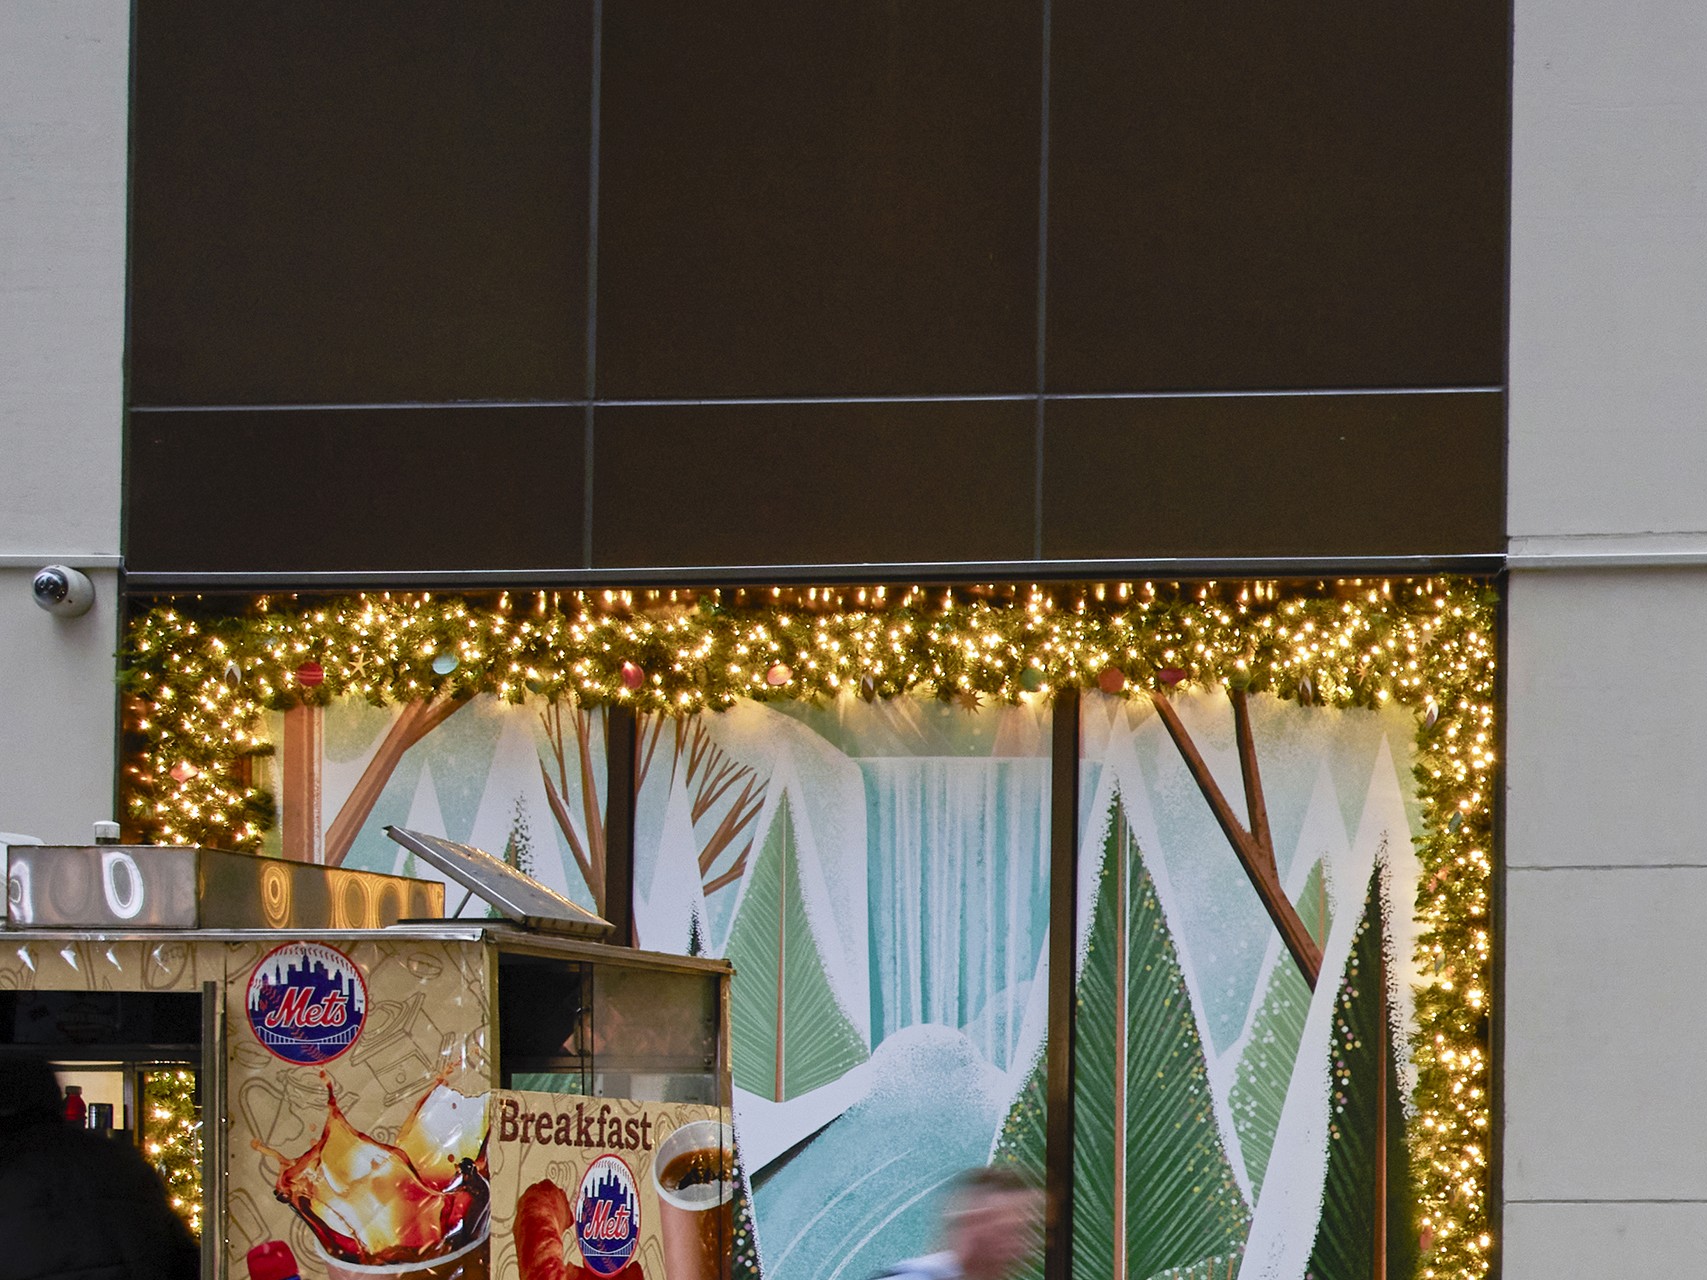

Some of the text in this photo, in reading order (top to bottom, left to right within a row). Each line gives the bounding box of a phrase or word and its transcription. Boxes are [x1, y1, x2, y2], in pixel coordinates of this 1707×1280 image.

[265, 986, 349, 1028] Mets
[499, 1099, 653, 1150] Breakfast
[583, 1199, 631, 1241] Mets
